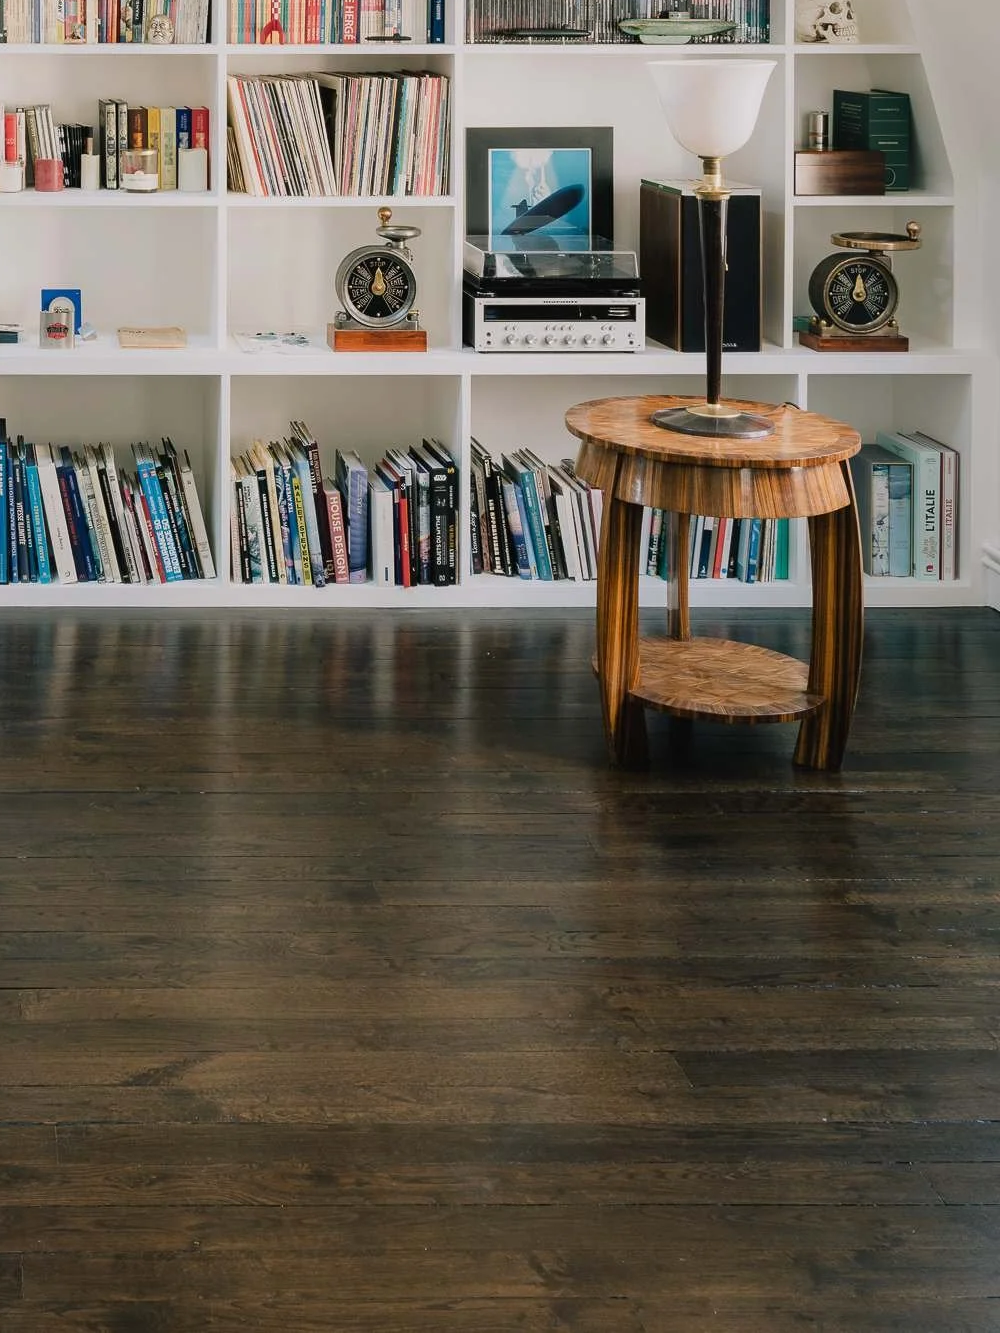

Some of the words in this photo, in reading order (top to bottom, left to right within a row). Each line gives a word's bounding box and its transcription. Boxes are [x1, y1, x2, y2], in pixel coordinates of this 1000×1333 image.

[343, 5, 355, 41] HERGÉ
[284, 483, 292, 502] AVERY
[15, 502, 24, 520] VITESSE
[329, 496, 342, 533] HOUSE
[925, 488, 934, 531] L'ITALIE
[10, 531, 16, 539] DE
[152, 518, 162, 530] 50
[160, 518, 170, 530] 50
[155, 529, 173, 573] ENDURANCE
[163, 529, 181, 574] ENDURANCE
[435, 535, 441, 543] DU
[333, 535, 346, 575] DESIGN
